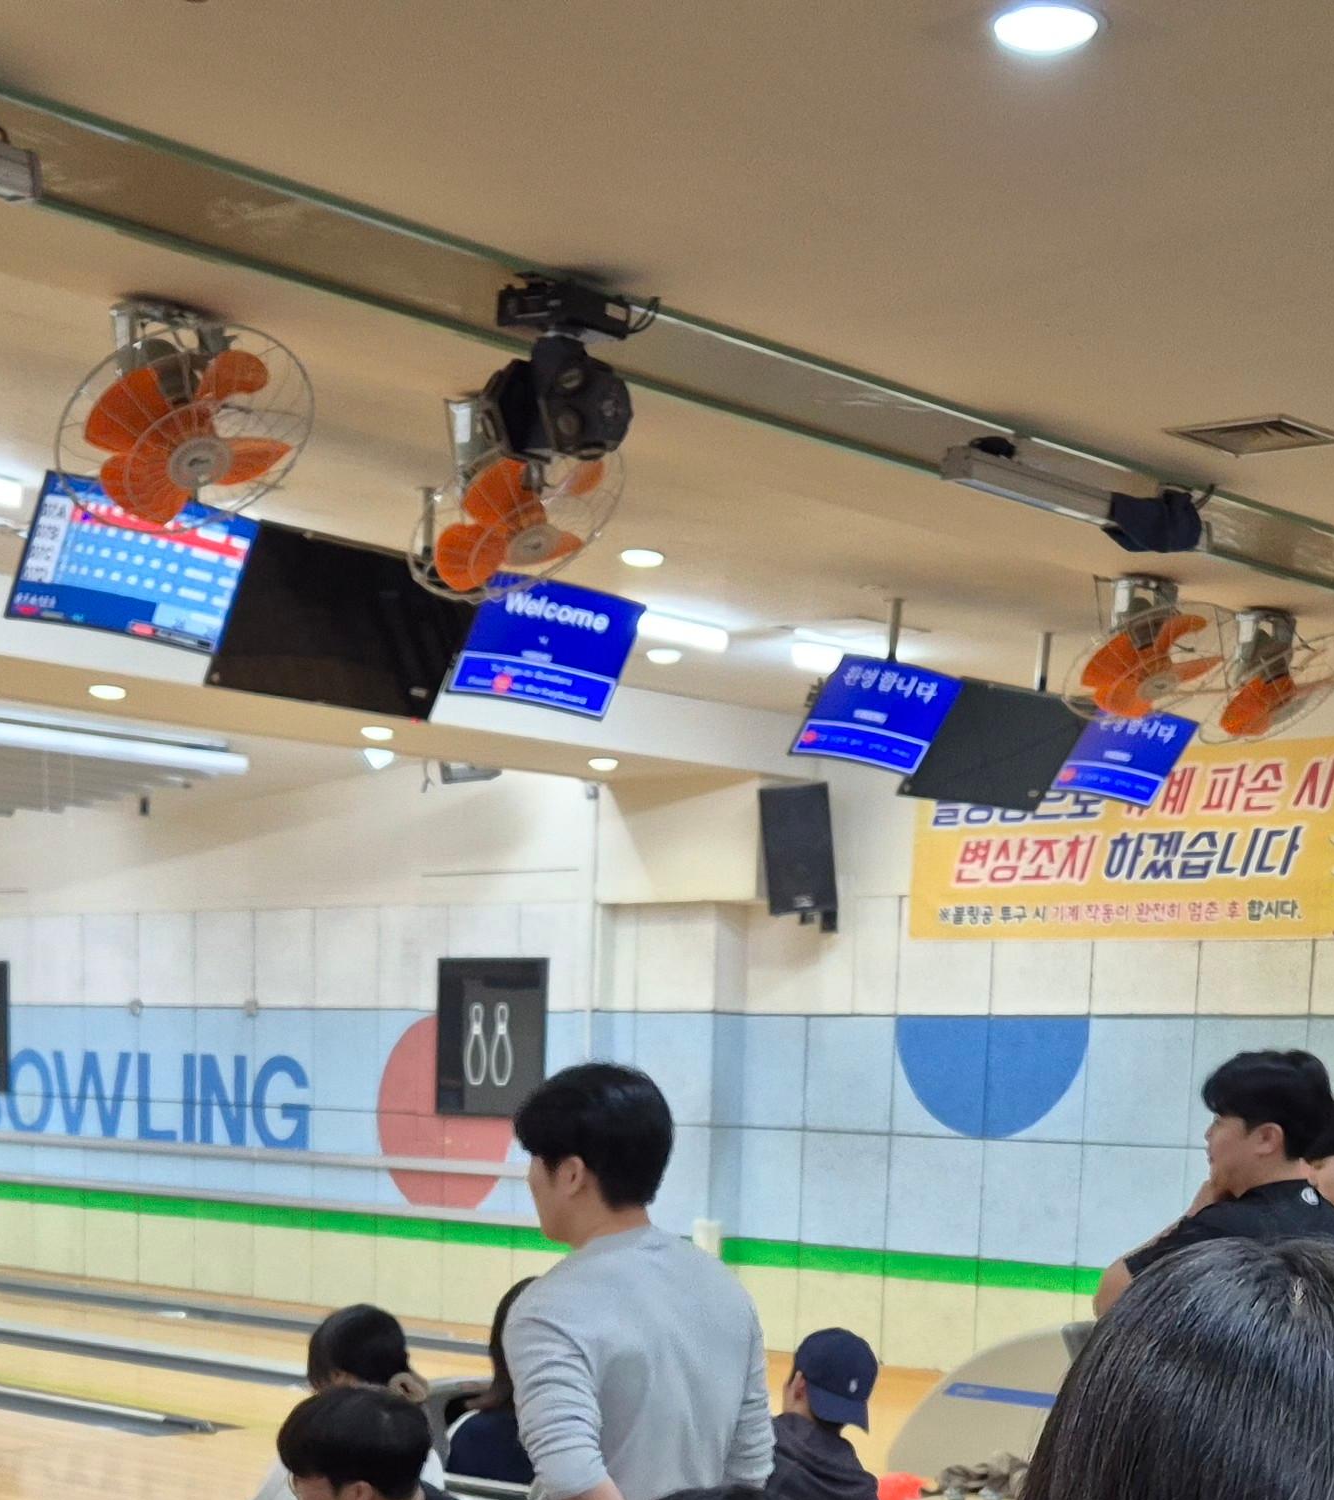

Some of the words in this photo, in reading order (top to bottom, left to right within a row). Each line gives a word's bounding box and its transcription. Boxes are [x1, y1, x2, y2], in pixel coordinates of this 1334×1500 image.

[505, 591, 610, 633] Welcome
[1201, 763, 1283, 812] 파손
[955, 835, 1098, 883] 변상조치
[1104, 826, 1303, 880] 하겠습니다
